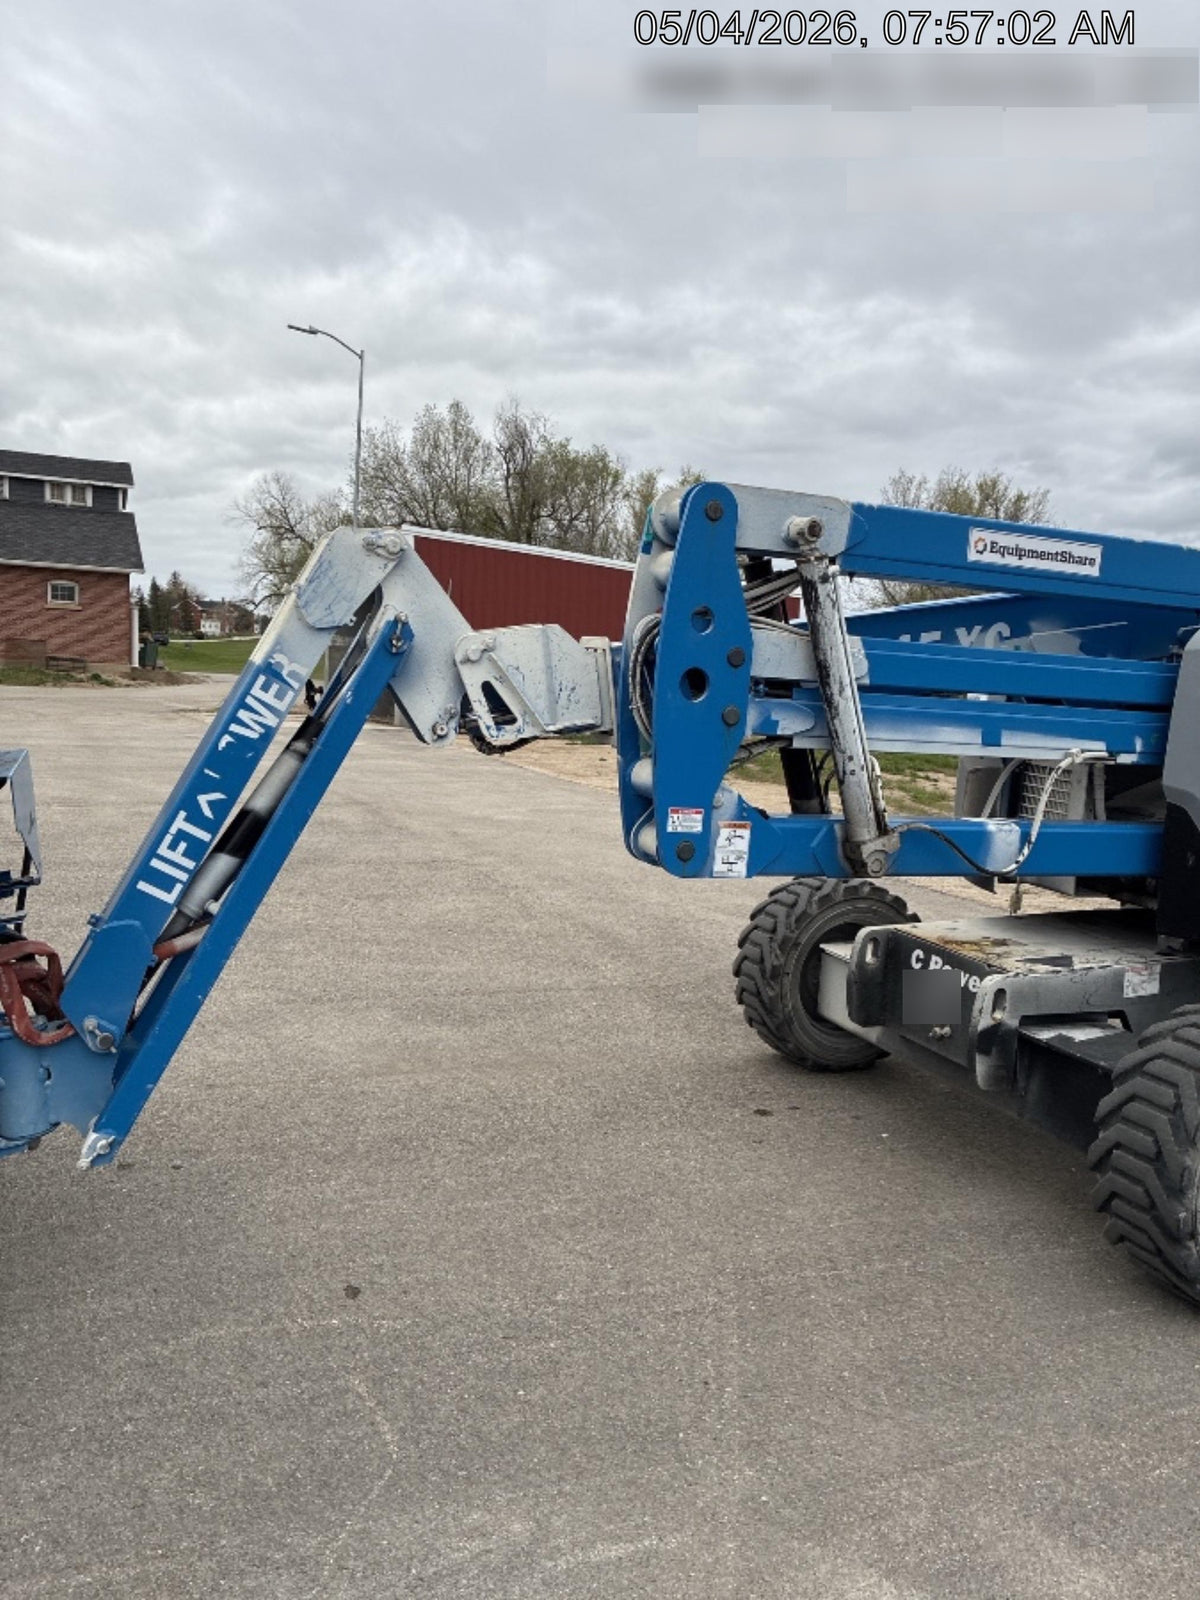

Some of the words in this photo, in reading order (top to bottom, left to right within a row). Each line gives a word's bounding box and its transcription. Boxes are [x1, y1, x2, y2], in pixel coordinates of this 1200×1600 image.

[989, 541, 1097, 567] EquipmentShare
[136, 809, 212, 905] LIFT
[203, 652, 305, 780] WER
